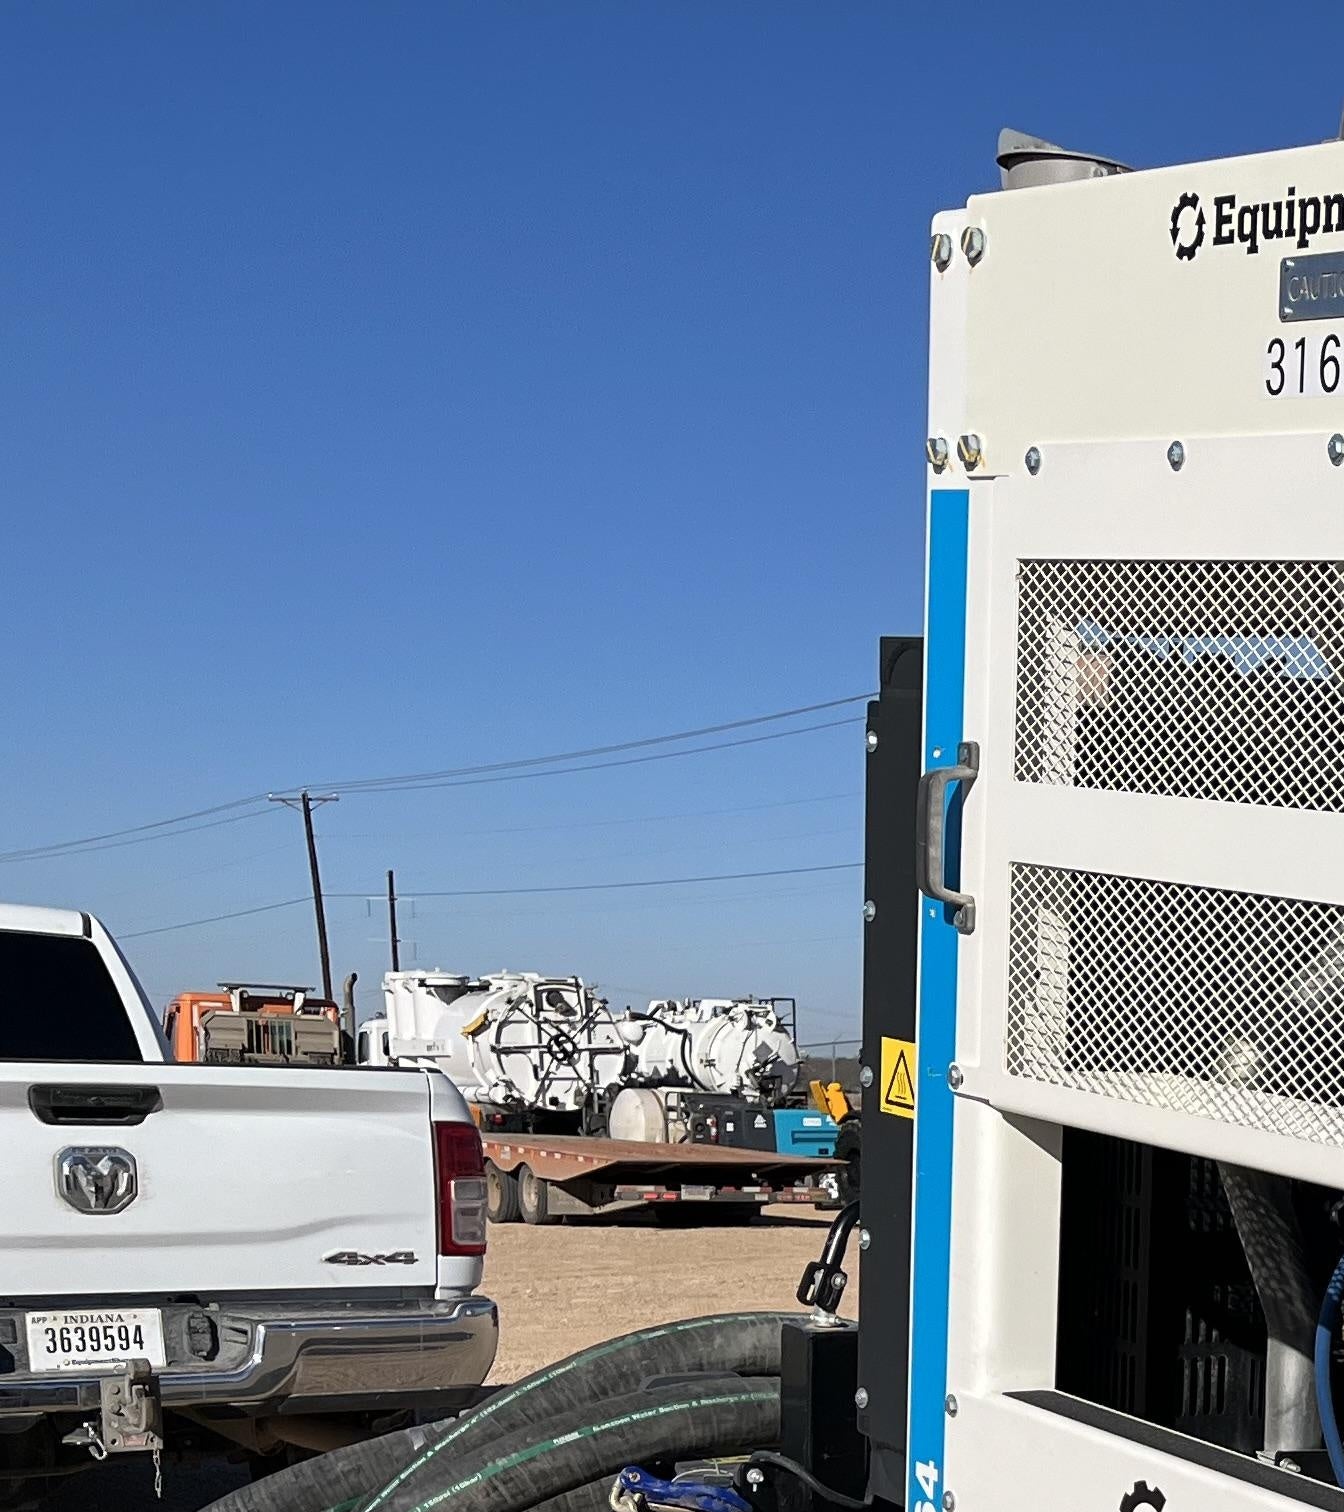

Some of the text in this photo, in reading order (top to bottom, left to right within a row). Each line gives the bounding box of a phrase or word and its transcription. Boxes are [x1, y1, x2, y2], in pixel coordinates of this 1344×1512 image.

[321, 1248, 419, 1266] 4x4
[64, 1313, 124, 1325] INDIANA
[44, 1324, 145, 1353] 3639594
